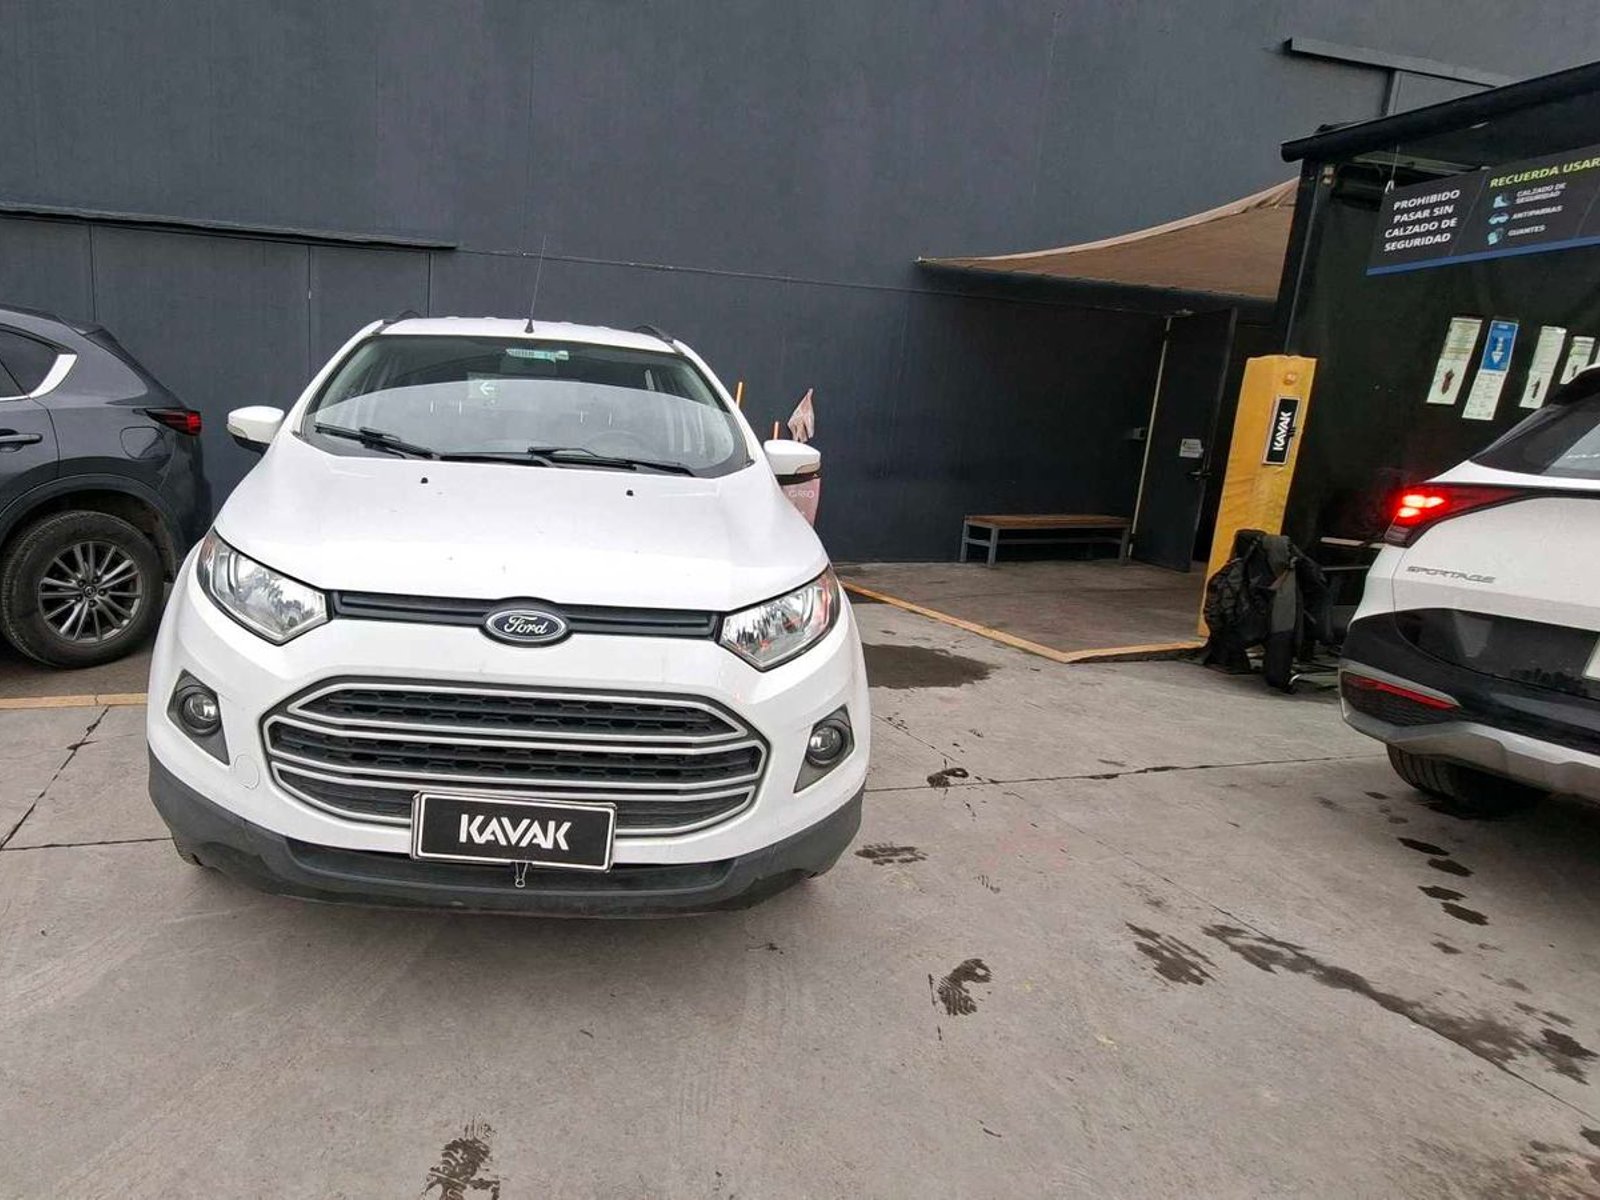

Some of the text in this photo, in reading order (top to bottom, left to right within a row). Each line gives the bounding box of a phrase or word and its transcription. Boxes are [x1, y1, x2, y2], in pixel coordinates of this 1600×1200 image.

[1490, 157, 1600, 188] RECUERDA USAR
[1393, 189, 1461, 211] PROHIBIDO
[1393, 204, 1455, 224] PASAR SIN
[1385, 217, 1459, 238] CALZADO DE
[1507, 224, 1546, 237] GUANTES
[1384, 233, 1451, 252] SEGURIDAD
[1273, 411, 1292, 451] KAVAK
[1407, 566, 1496, 583] SPORTAGE
[504, 615, 548, 635] Ford
[459, 814, 572, 851] KAVAK
